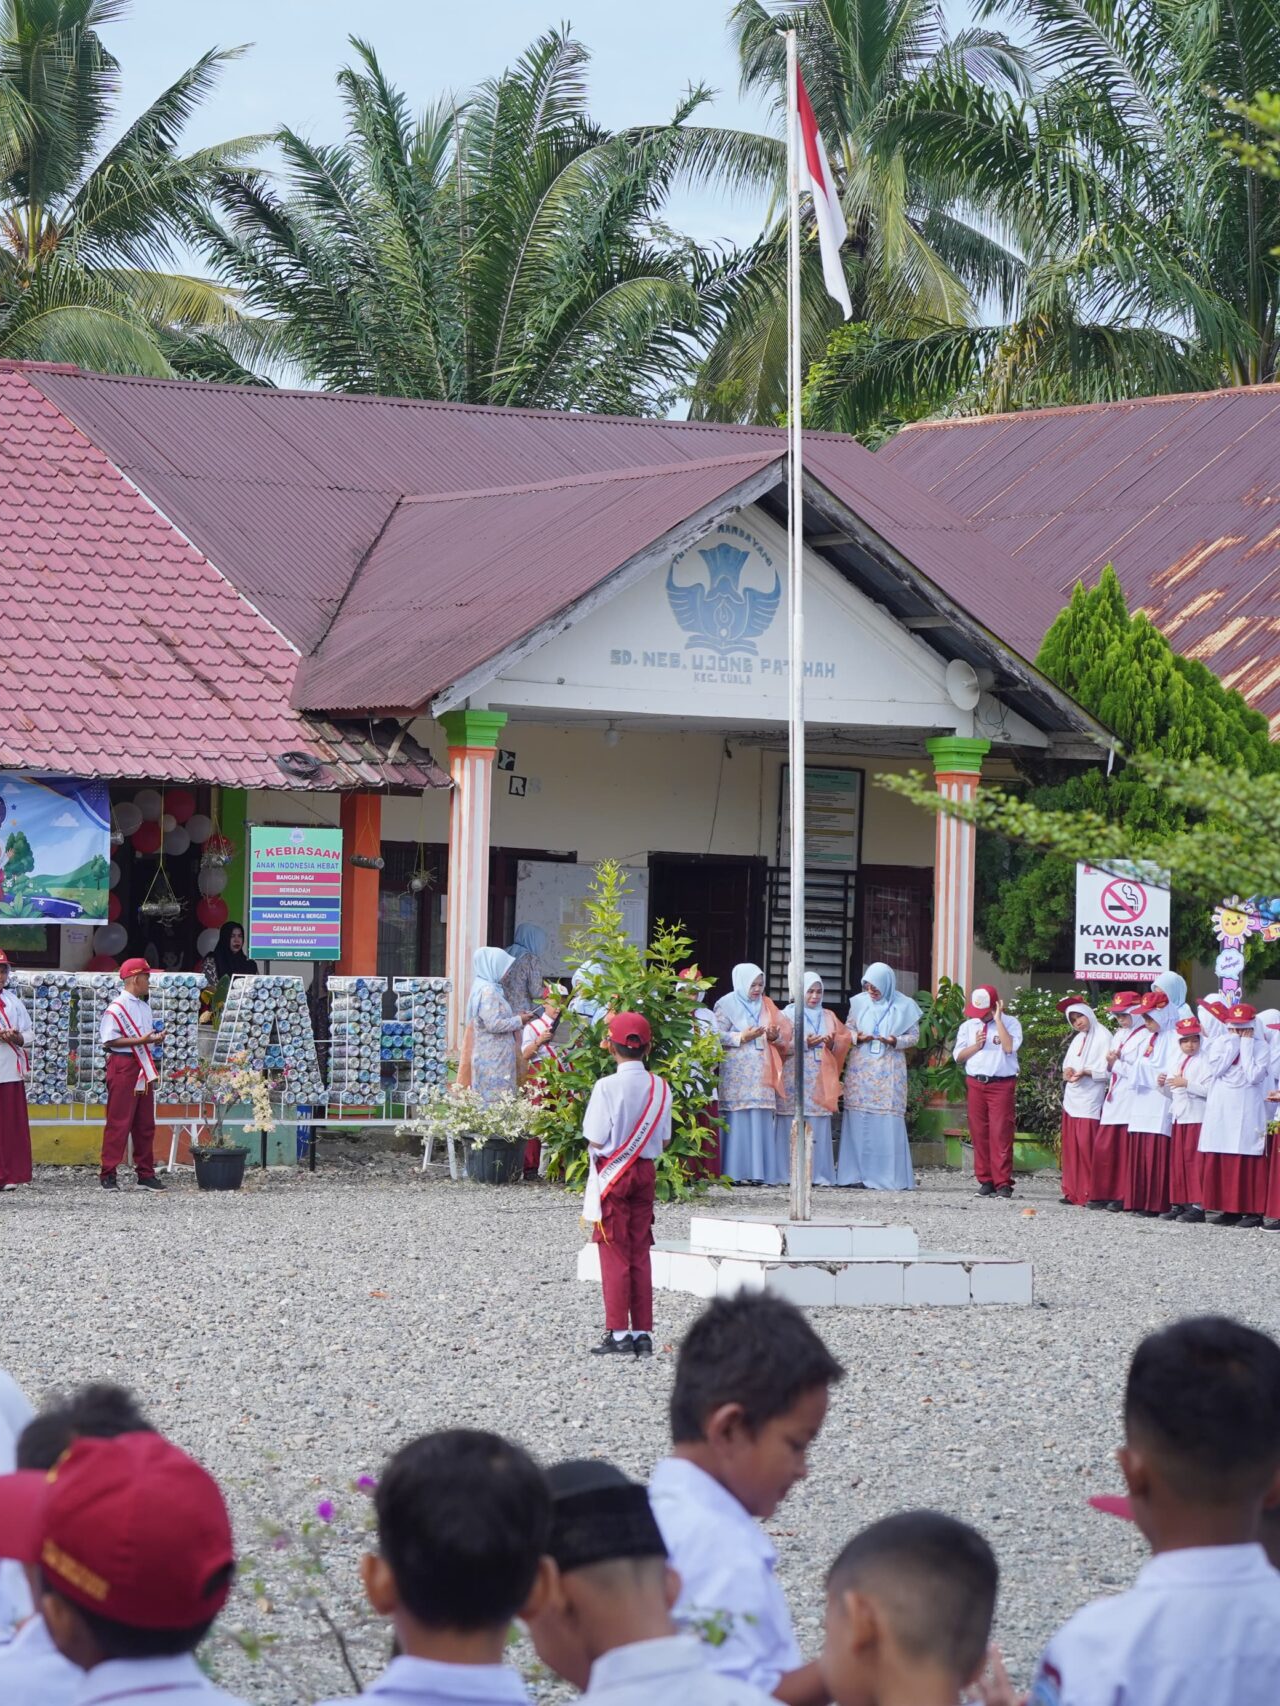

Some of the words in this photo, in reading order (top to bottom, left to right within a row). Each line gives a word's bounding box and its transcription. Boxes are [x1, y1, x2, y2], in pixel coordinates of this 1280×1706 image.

[610, 649, 637, 665] SD.
[692, 654, 753, 673] UJONG
[760, 658, 835, 679] PAHAH
[721, 673, 752, 685] KUALA
[254, 850, 261, 859] 7
[265, 846, 341, 860] KEBIASAAN
[317, 862, 339, 870] HEBAT
[1080, 925, 1169, 938] KAWASAN
[1093, 939, 1155, 951] TANPA
[1084, 953, 1162, 967] ROKOK
[1087, 972, 1113, 980] NEGERI
[1114, 972, 1138, 980] UJONG
[628, 1122, 651, 1153] UPACARA
